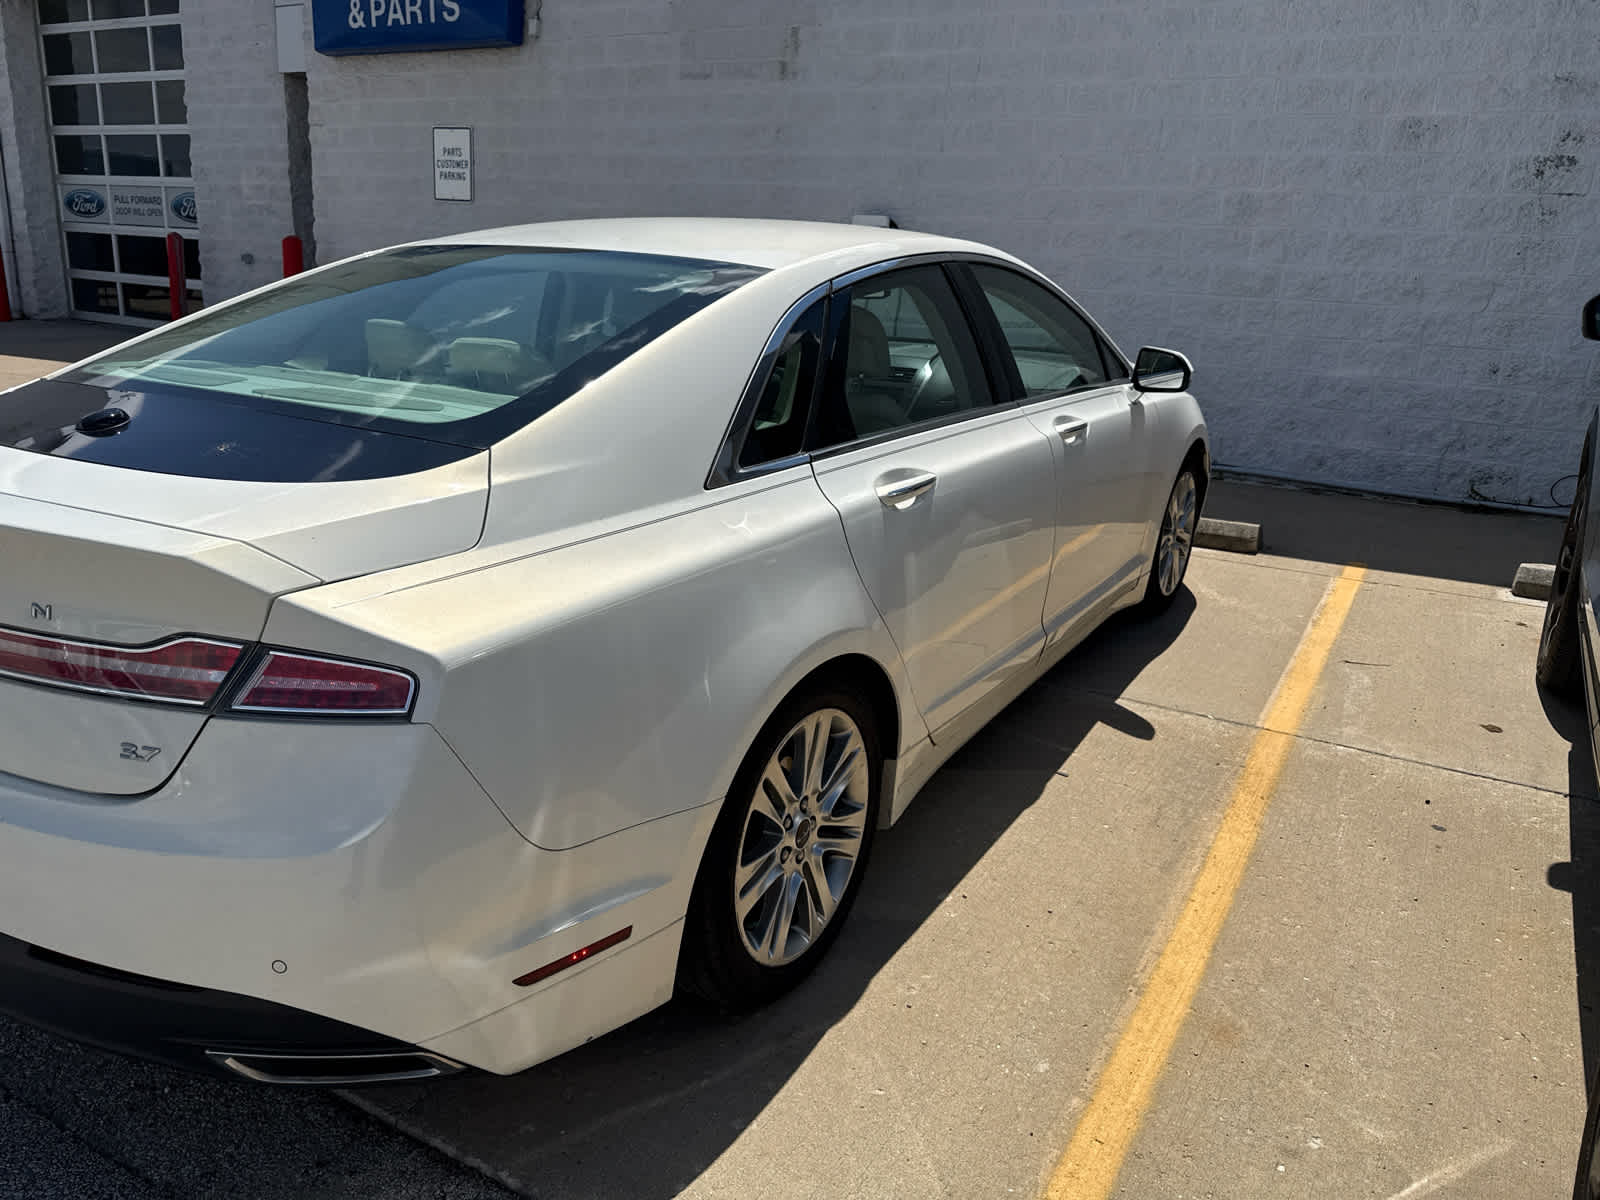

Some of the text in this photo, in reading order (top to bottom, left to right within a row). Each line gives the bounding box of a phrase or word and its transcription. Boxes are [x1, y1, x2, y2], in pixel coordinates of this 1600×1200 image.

[443, 147, 462, 157] PARTS
[436, 160, 470, 168] CUSTOMER
[440, 171, 466, 181] PARKING
[72, 193, 98, 212] Ford
[114, 195, 161, 205] PULL FORWARD
[115, 207, 163, 217] DOOR WILL OPEN
